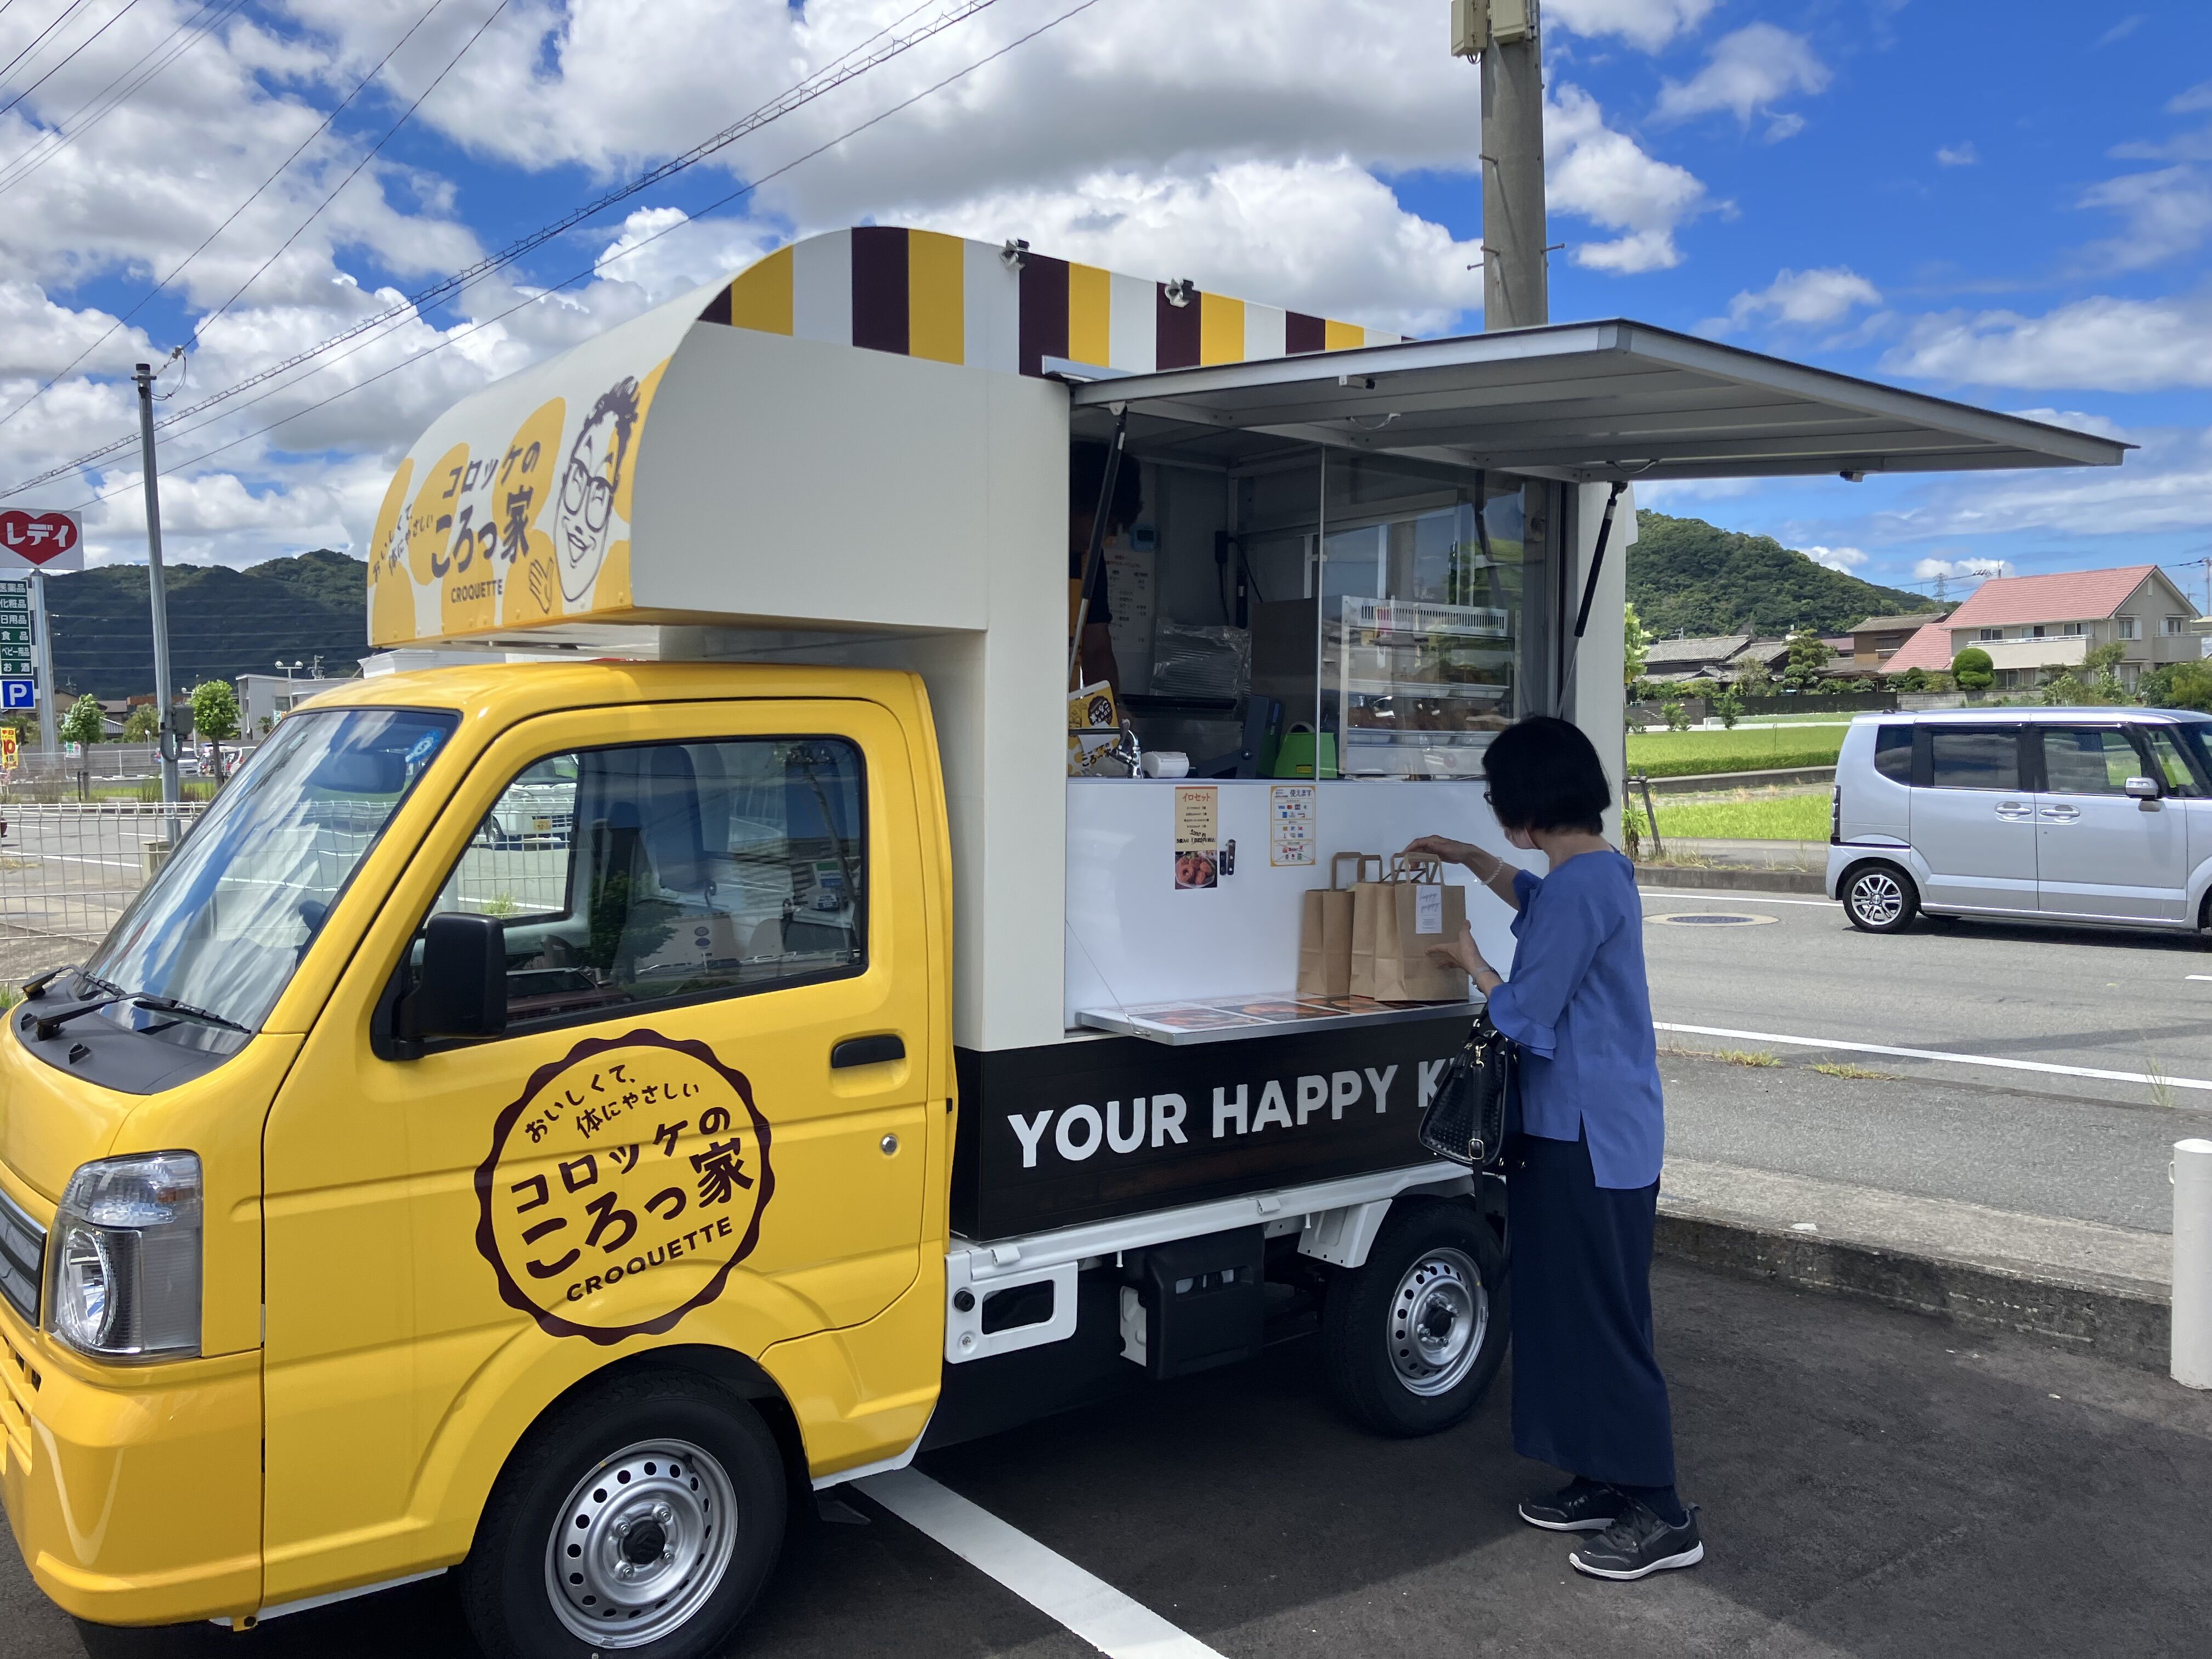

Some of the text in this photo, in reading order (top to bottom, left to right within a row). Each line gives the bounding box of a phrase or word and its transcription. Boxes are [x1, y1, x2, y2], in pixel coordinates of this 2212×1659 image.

[442, 441, 541, 499] コロッケの
[7, 522, 69, 548] レディ
[431, 484, 534, 578] ころっ家
[0, 599, 26, 608] 化粧品
[1, 614, 27, 624] 日用品
[450, 578, 504, 603] CROQUETTE
[9, 684, 27, 706] P
[1290, 789, 1312, 797] 使えます
[525, 1065, 636, 1143] おいしくて、
[575, 1082, 699, 1139] 体にやさしい
[1007, 1057, 1455, 1169] YOUR HAPPY K
[511, 1107, 731, 1214] コロッケの
[522, 1137, 754, 1279] ころっ家
[566, 1216, 732, 1301] CROQUETTE
